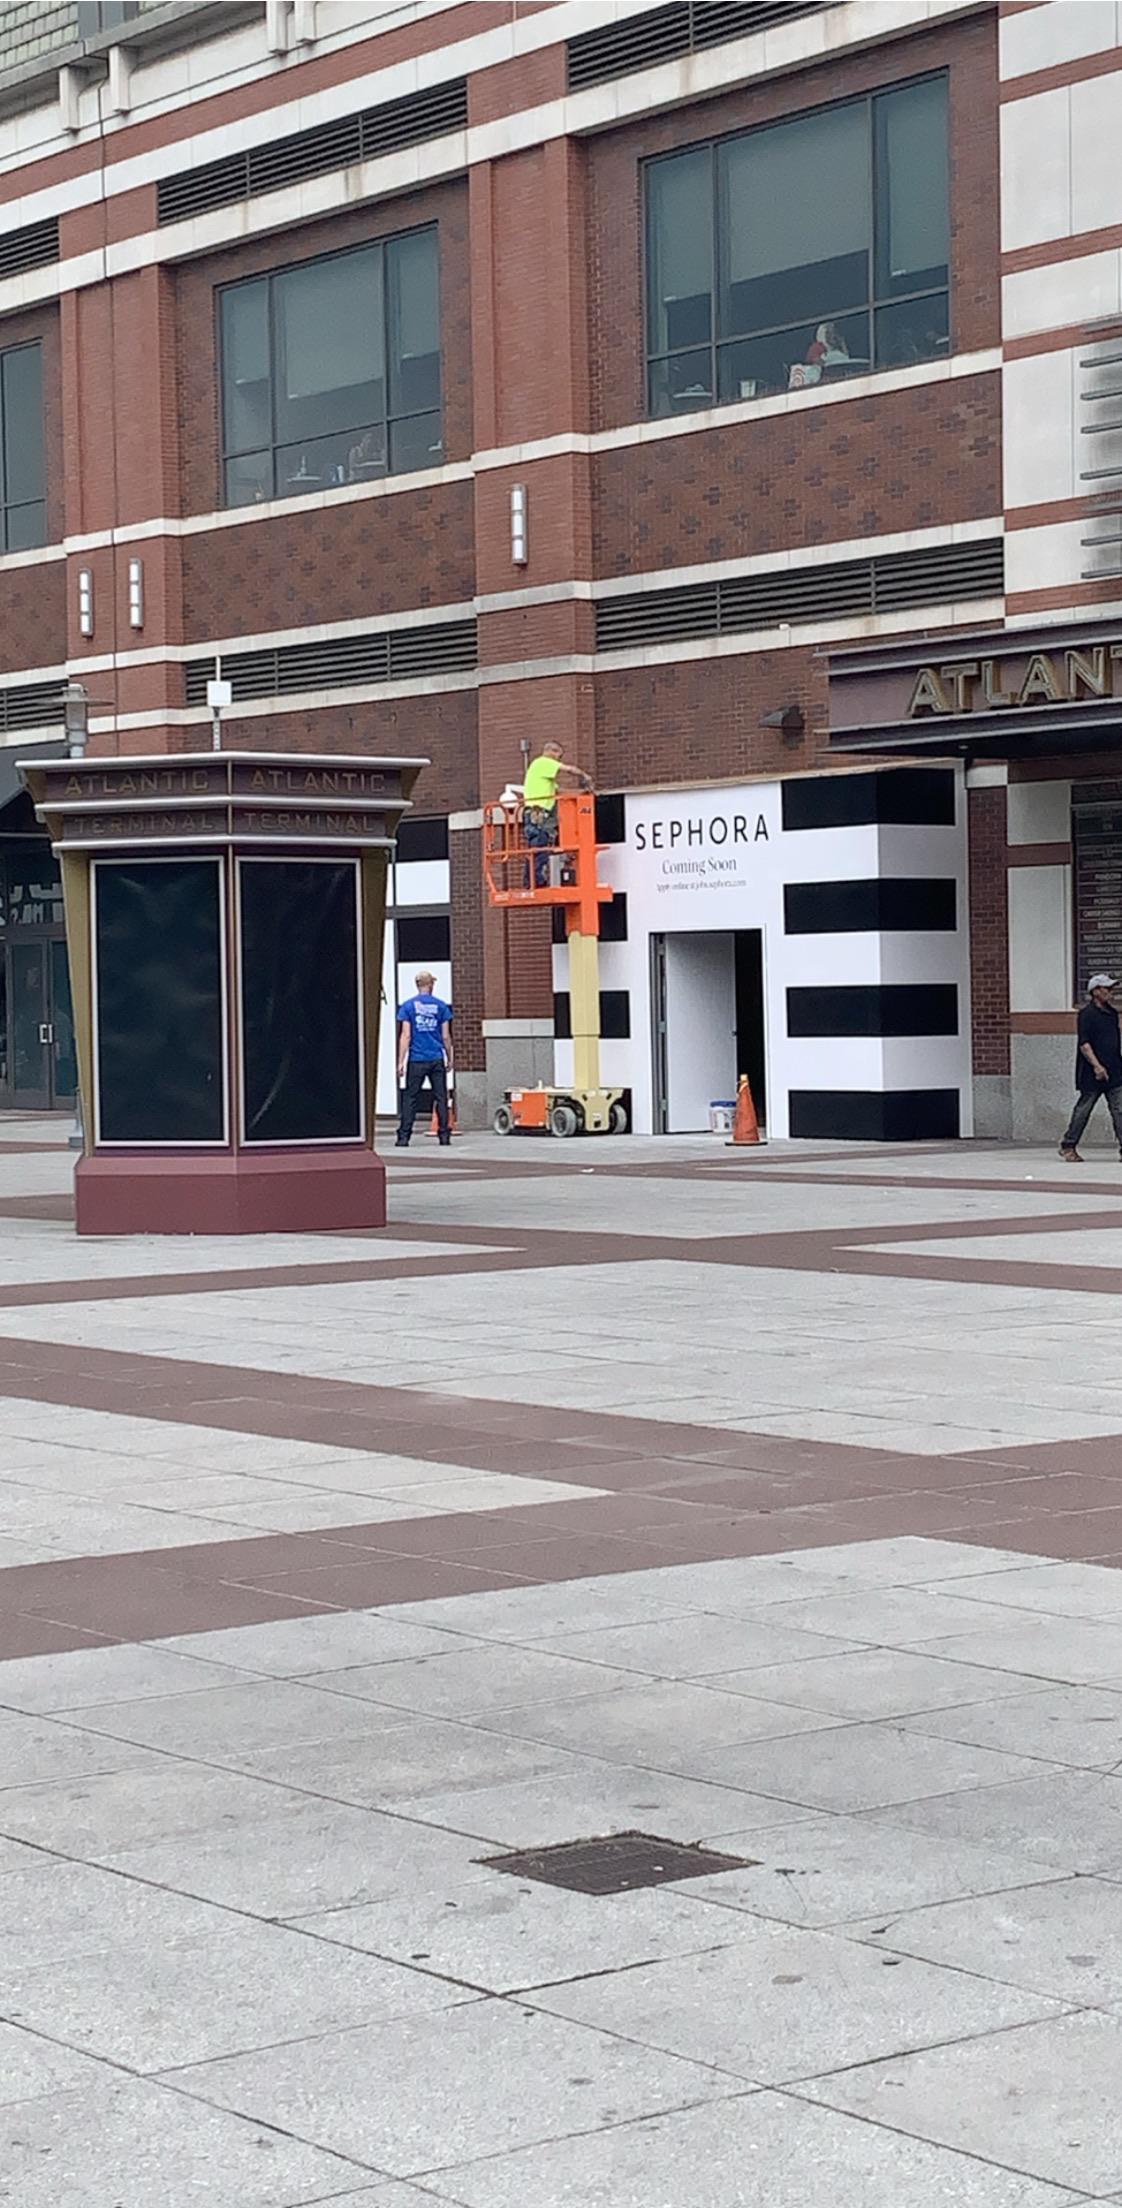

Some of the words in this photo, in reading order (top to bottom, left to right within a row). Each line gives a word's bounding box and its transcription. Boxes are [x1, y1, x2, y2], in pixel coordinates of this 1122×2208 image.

[64, 770, 209, 796] ATLANTIC
[250, 769, 386, 793] ATLANTIC
[74, 811, 214, 834] TERMINAL
[243, 812, 374, 832] TERMINAL
[635, 814, 769, 851] SEPHORA
[662, 859, 706, 876] Coming
[707, 857, 737, 872] Soon
